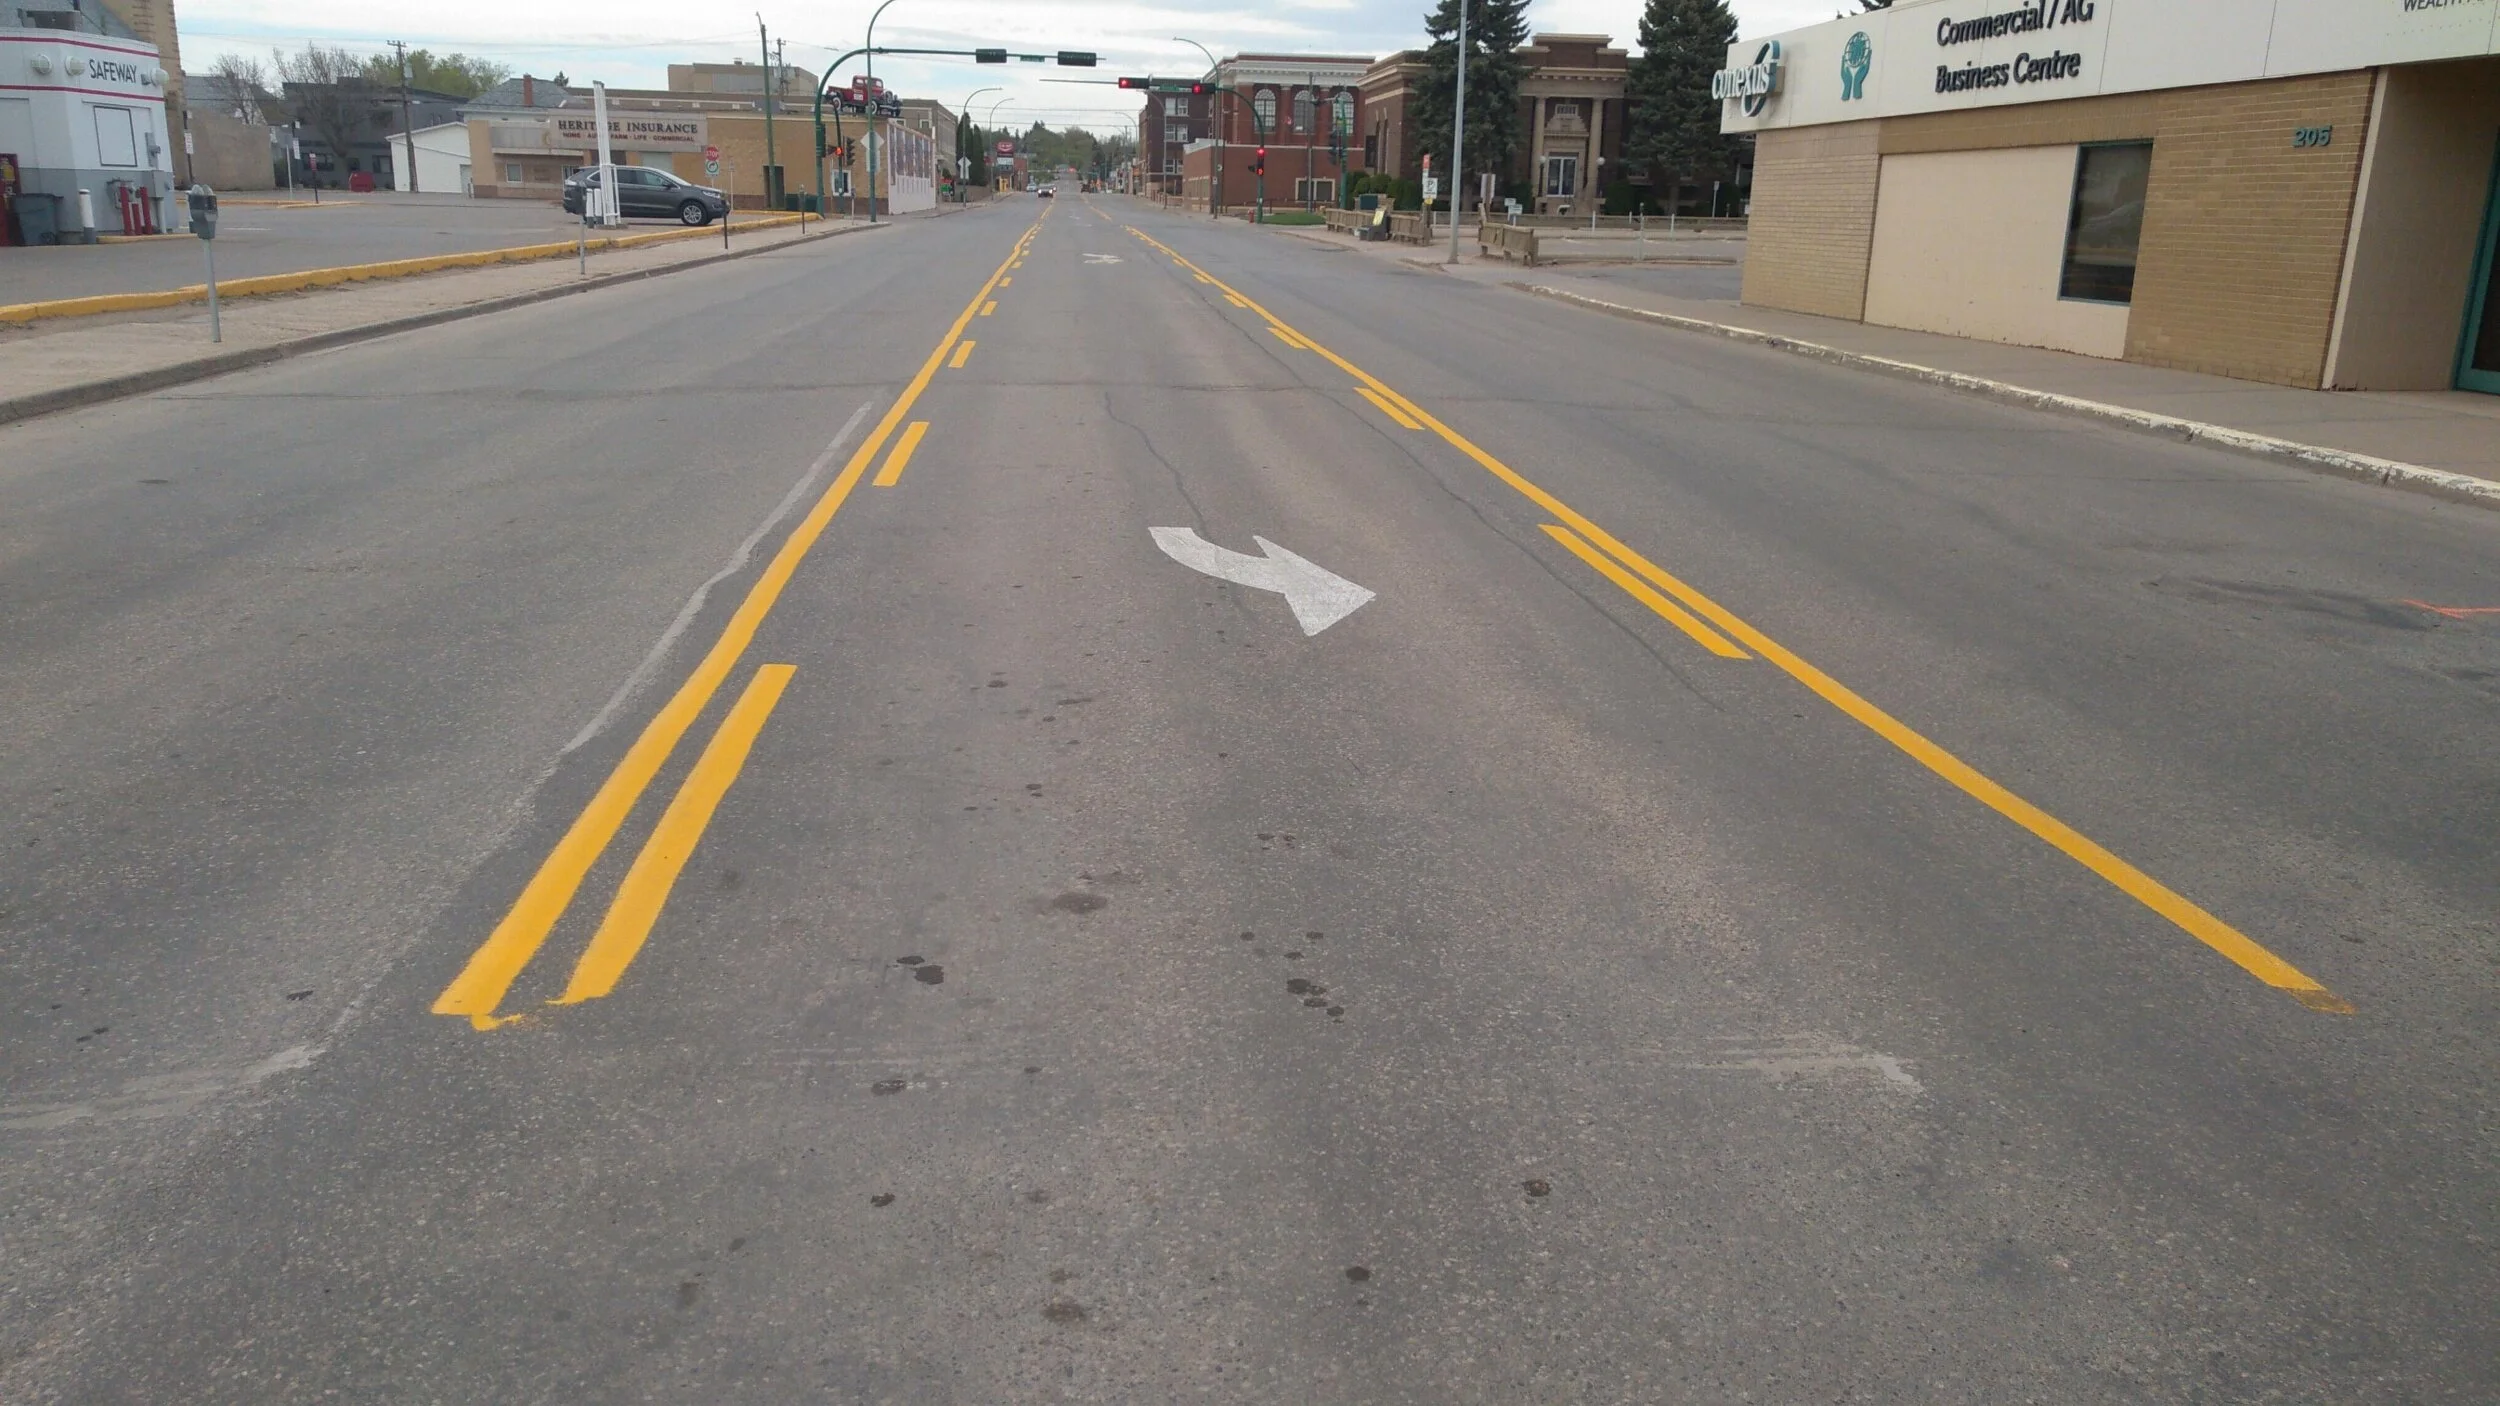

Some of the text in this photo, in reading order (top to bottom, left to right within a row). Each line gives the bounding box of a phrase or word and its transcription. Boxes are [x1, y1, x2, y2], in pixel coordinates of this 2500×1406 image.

[2403, 0, 2461, 12] WEA
[1937, 0, 2044, 46] Commercial
[89, 59, 137, 83] SAFEWAY
[1712, 63, 1771, 100] conexus
[1935, 50, 2082, 93] Business Centre
[558, 119, 698, 133] HERITGE INSURANCE
[2294, 125, 2333, 148] 205
